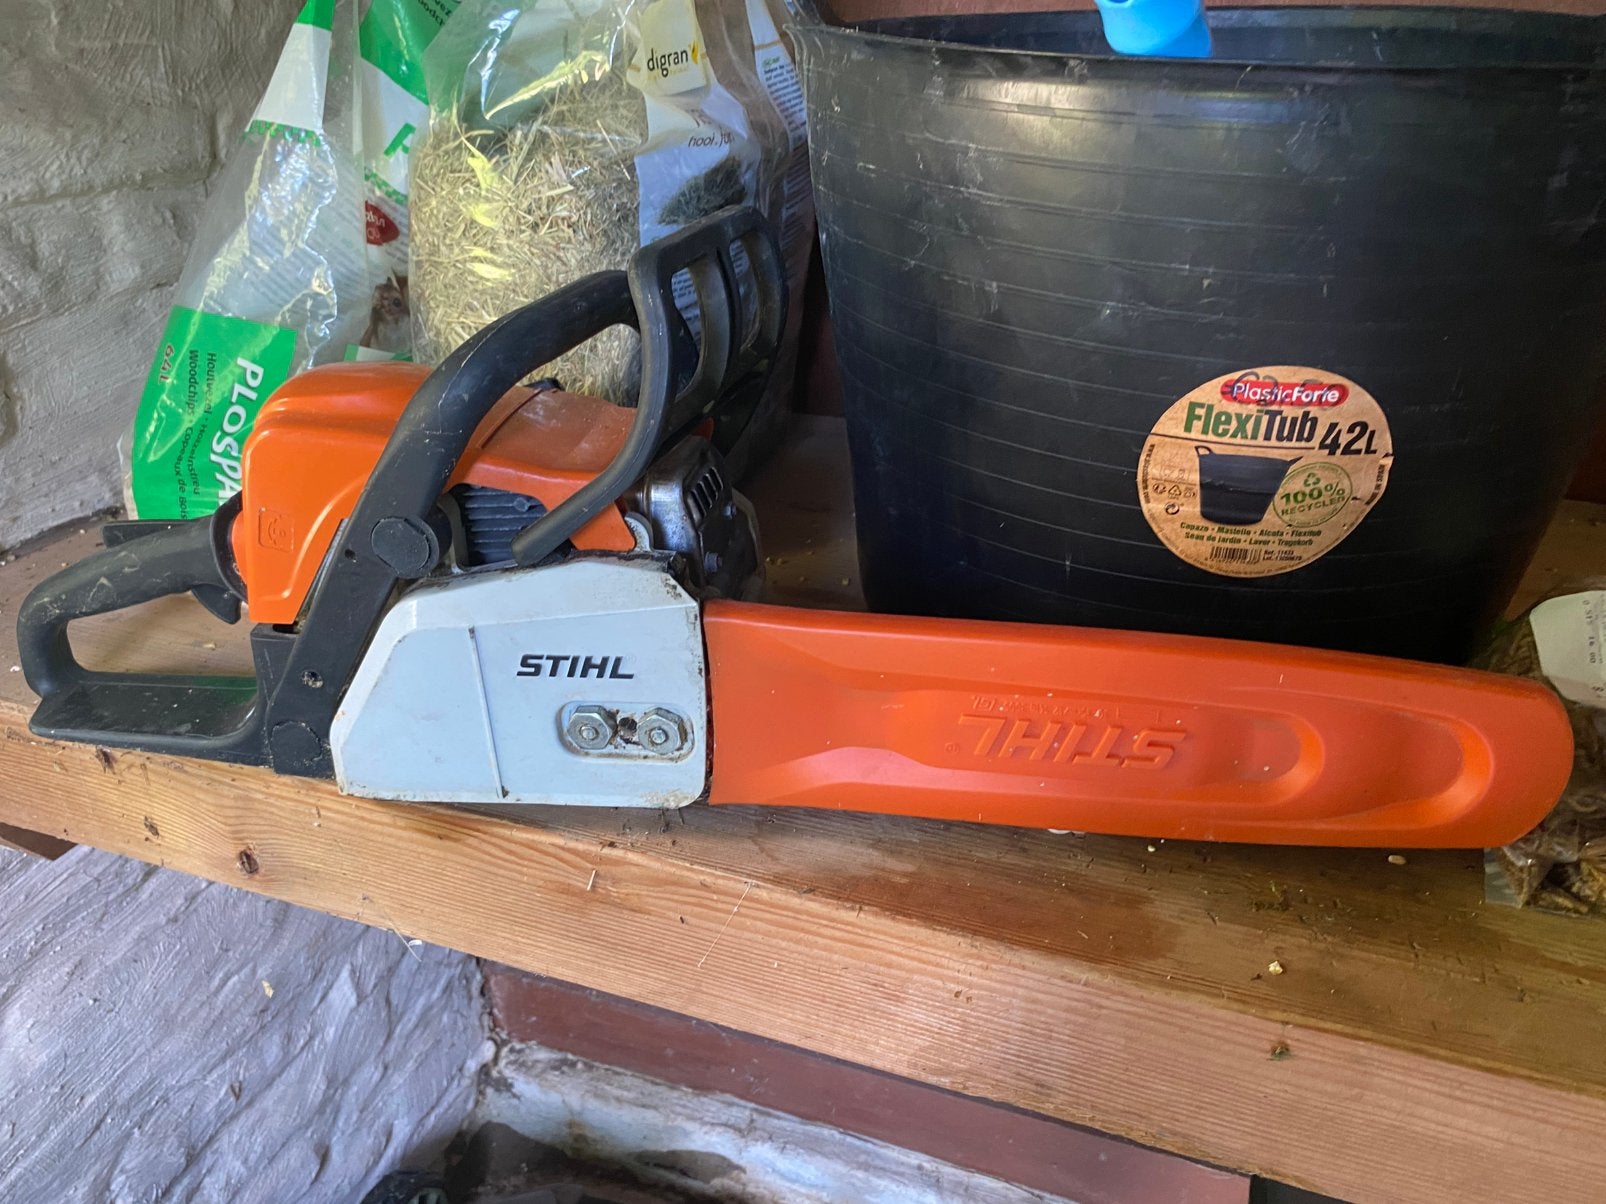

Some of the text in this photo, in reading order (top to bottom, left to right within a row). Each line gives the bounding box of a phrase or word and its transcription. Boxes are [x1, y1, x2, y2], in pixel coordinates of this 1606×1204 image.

[647, 48, 688, 77] digran
[186, 349, 199, 416] Woodchips
[1233, 382, 1340, 404] PlasticForte
[209, 357, 264, 506] PLOSPA
[1183, 401, 1319, 443] FlexiTub
[179, 478, 186, 493] de
[1280, 481, 1346, 506] 100%
[1281, 496, 1346, 516] RECYCLED
[1180, 521, 1209, 533] Capazo
[1216, 526, 1251, 536] Mastello
[1185, 532, 1205, 540] Seau
[1206, 534, 1216, 542] de
[516, 654, 635, 680] STIHL
[958, 713, 1187, 769] STIHL
